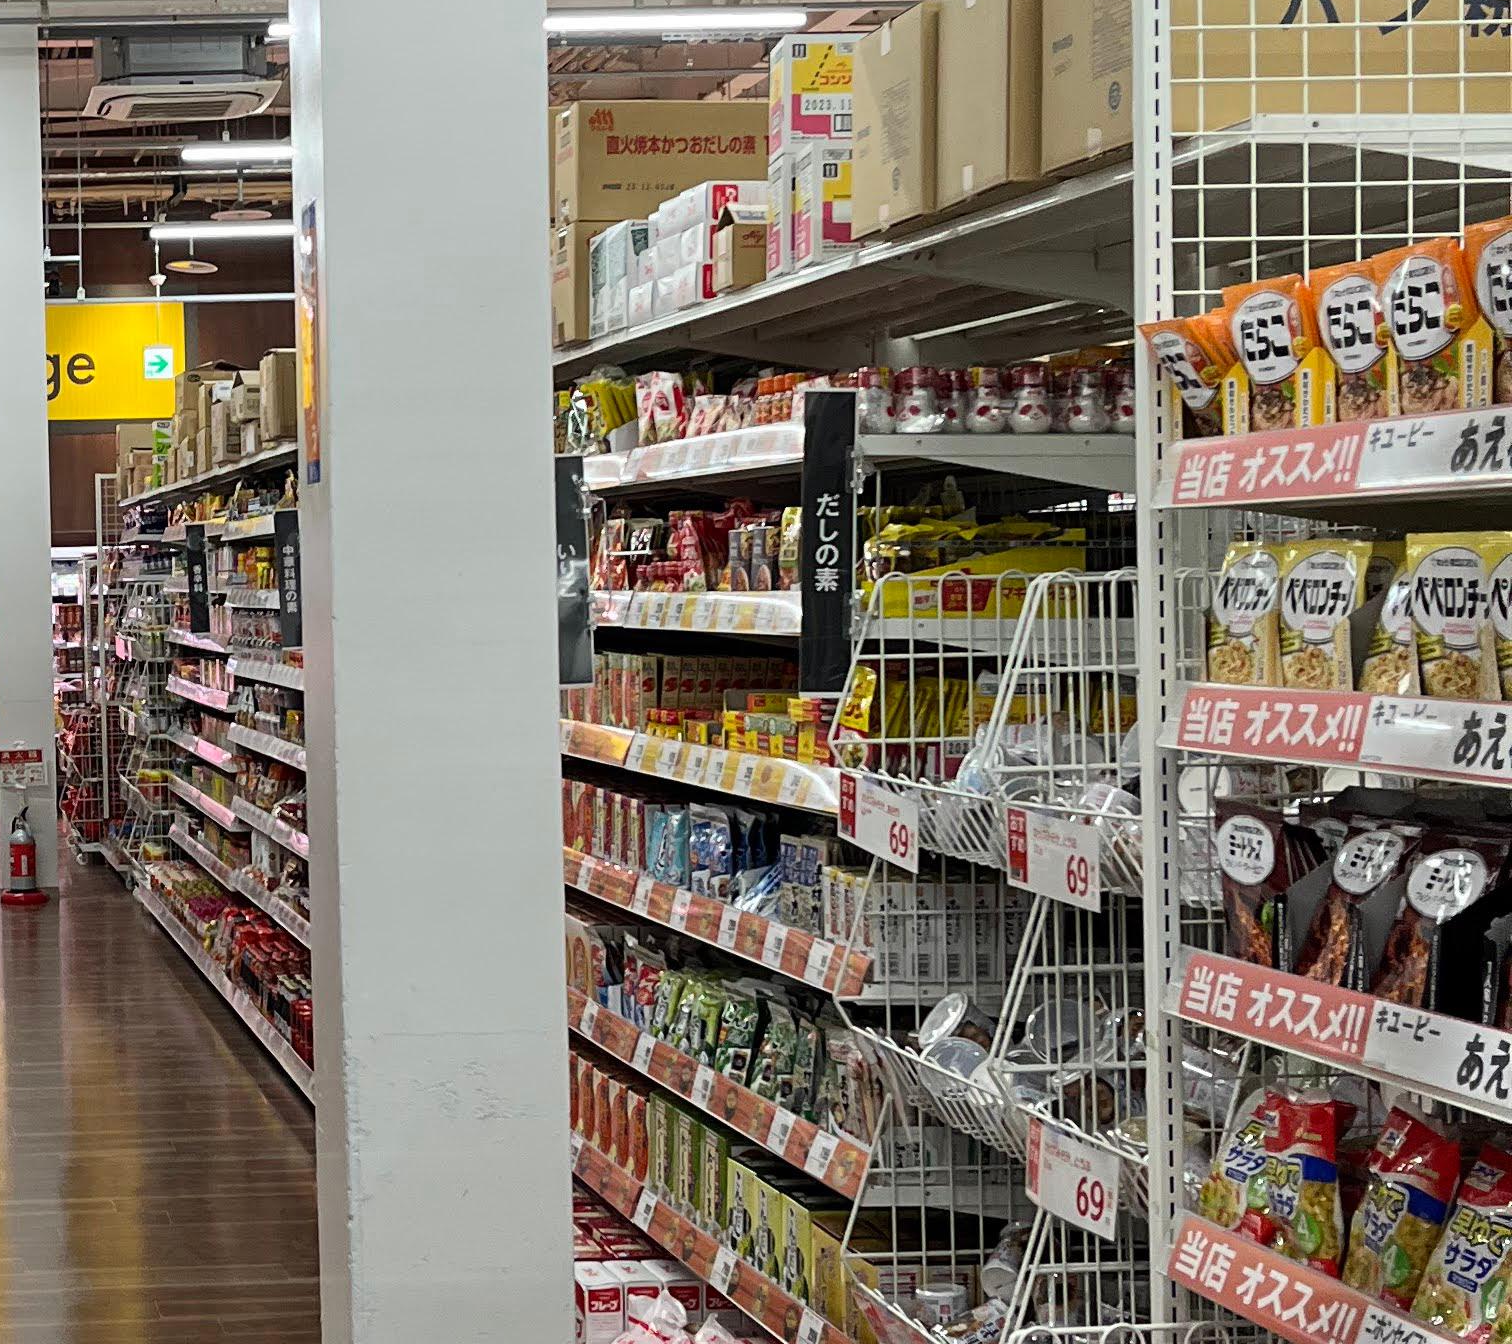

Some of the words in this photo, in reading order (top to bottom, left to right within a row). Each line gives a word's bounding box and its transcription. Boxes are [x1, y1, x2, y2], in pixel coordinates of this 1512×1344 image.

[1177, 451, 1235, 502] 当店
[1238, 434, 1361, 494] オススメ!!
[815, 493, 839, 592] だしの素
[1183, 696, 1240, 746] 当店
[1244, 700, 1364, 753] オススメ!!
[889, 821, 909, 858] 69
[1067, 855, 1088, 896] 69
[1185, 965, 1243, 1022] 当店
[1247, 983, 1366, 1054] オススメ!!
[1076, 1176, 1104, 1221] 69
[1174, 1229, 1238, 1295] 当店
